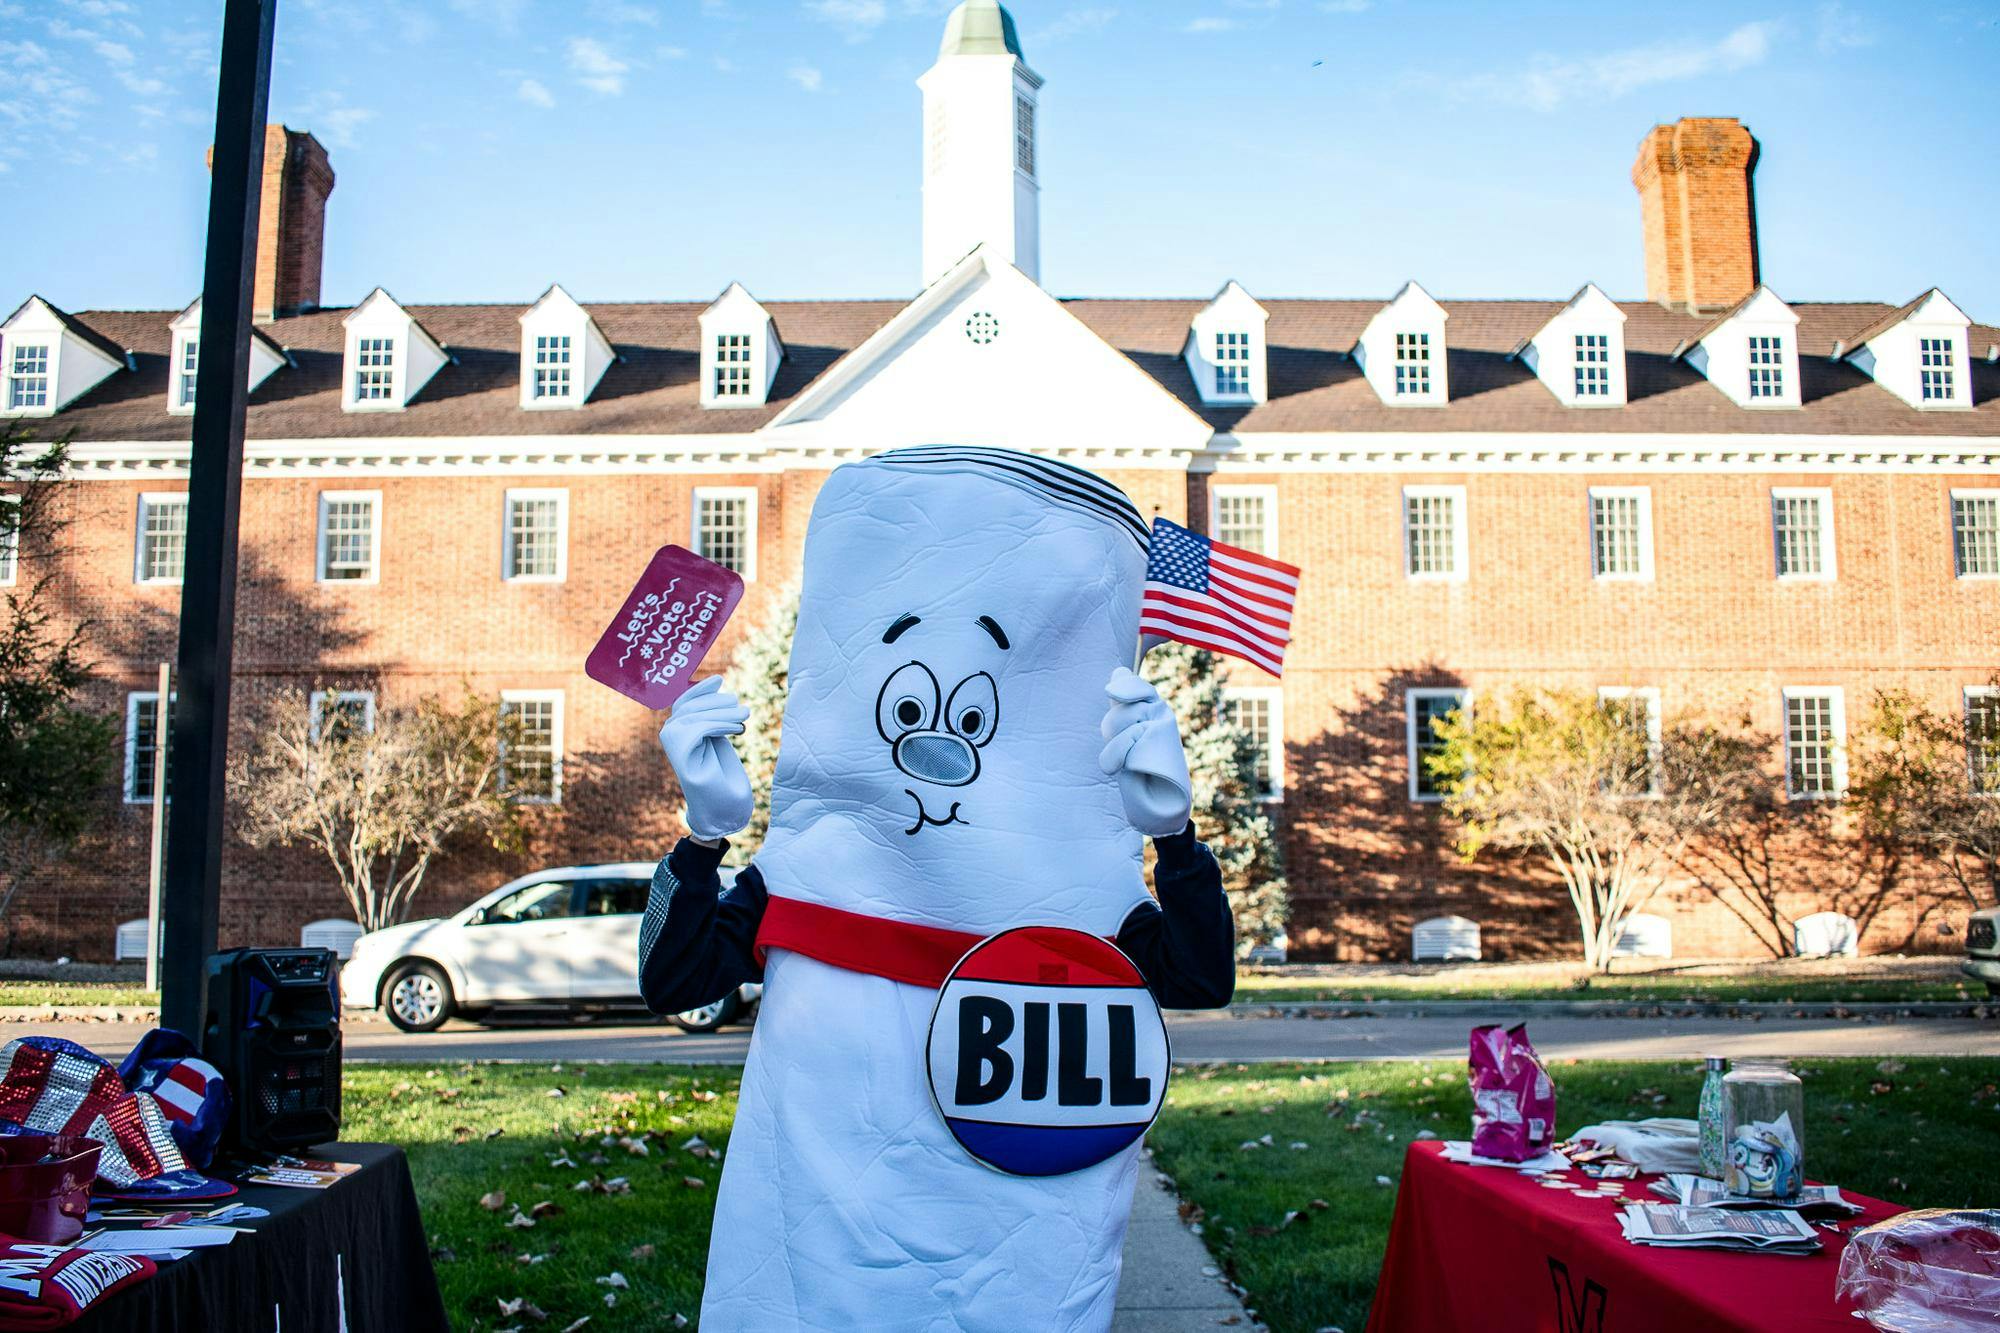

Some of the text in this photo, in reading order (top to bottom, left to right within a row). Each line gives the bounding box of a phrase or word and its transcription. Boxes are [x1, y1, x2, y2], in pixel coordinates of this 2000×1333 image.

[617, 593, 659, 643] Let's
[640, 601, 686, 660] #Vote
[652, 593, 723, 686] Together!
[954, 995, 1151, 1107] BILL
